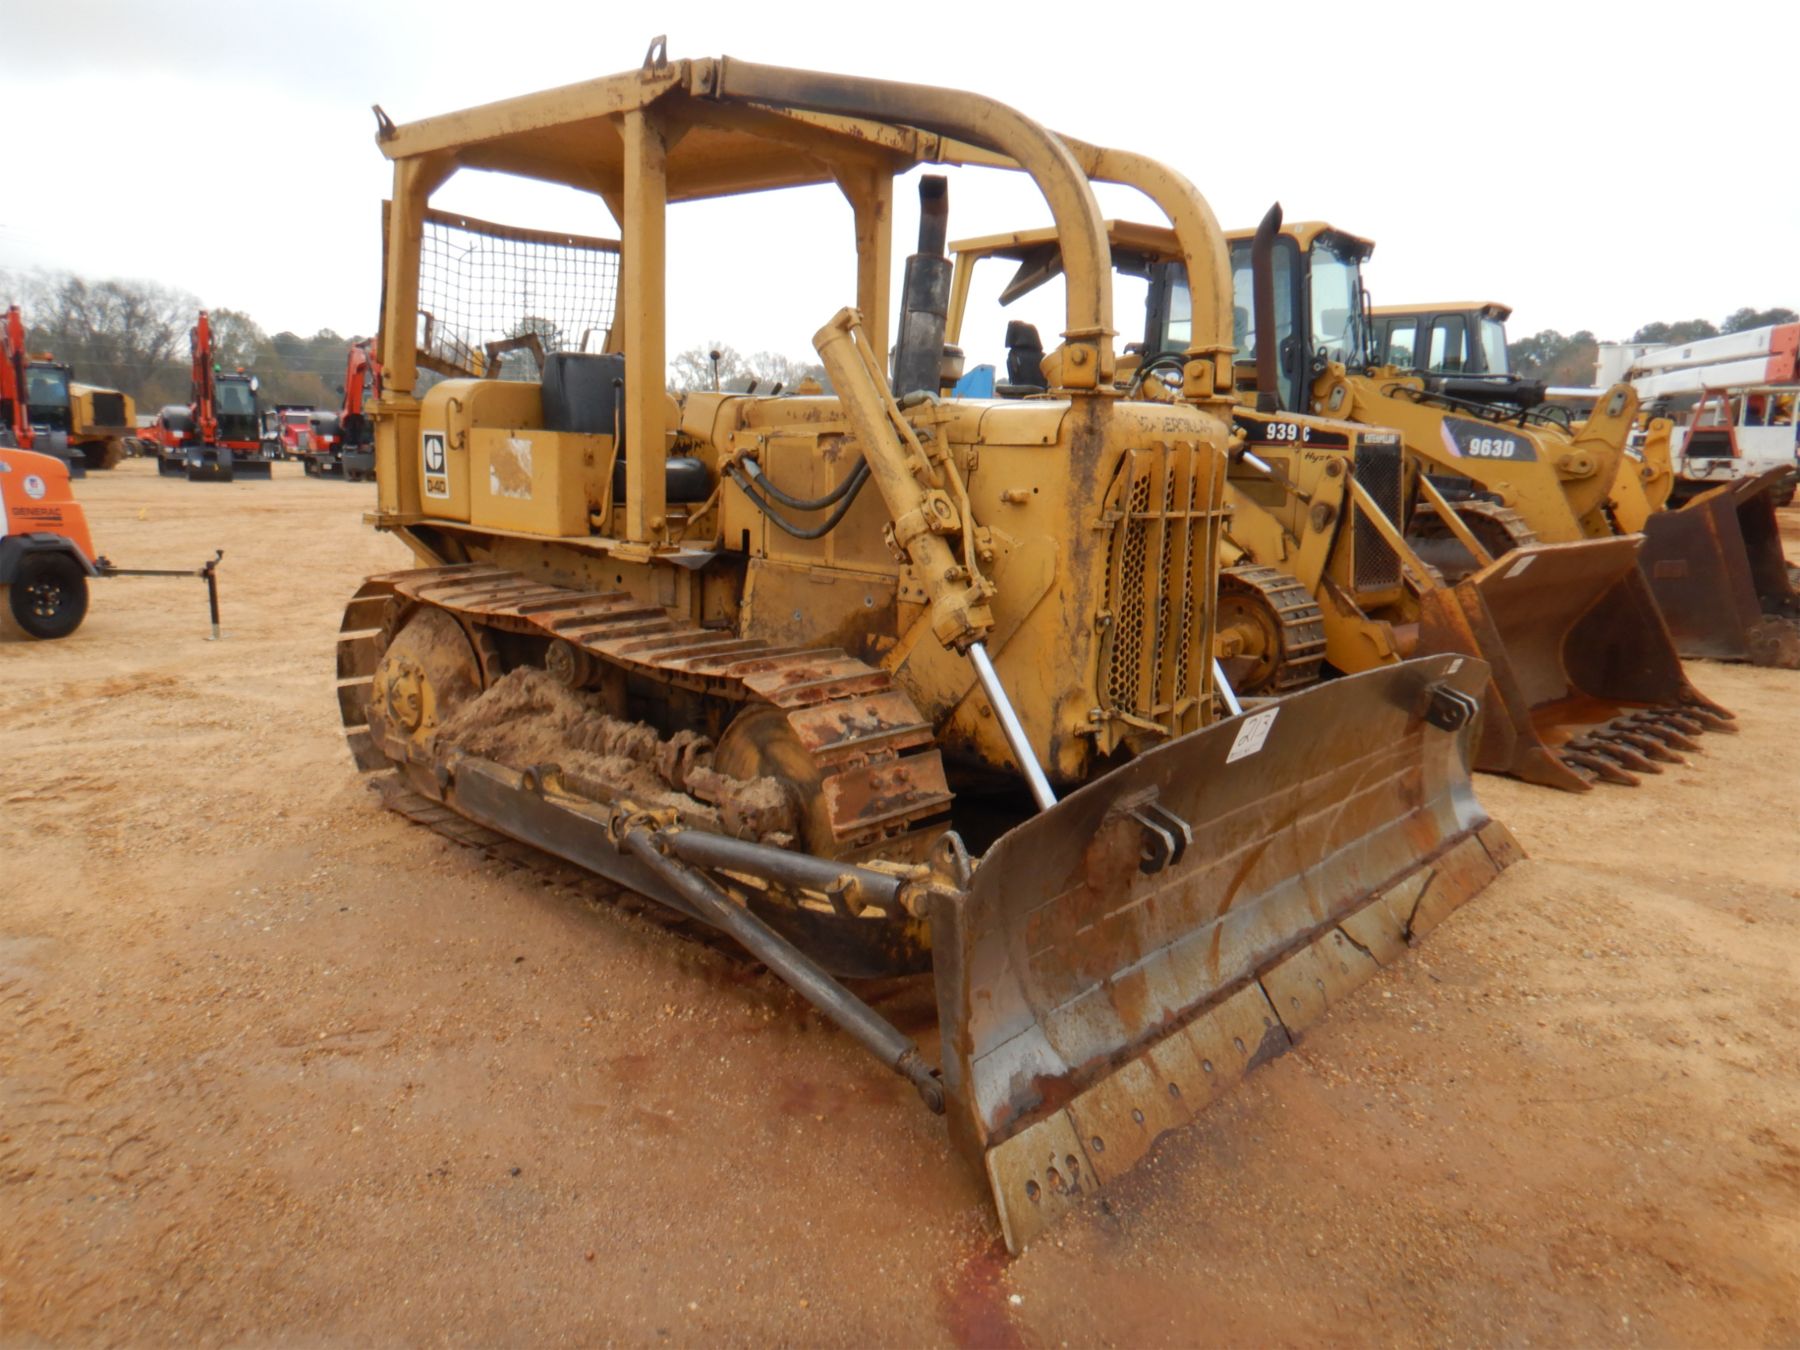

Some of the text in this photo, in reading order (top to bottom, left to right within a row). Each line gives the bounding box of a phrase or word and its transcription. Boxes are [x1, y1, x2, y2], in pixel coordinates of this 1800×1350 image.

[1266, 423, 1311, 442] 939 C
[1469, 437, 1515, 457] 963D
